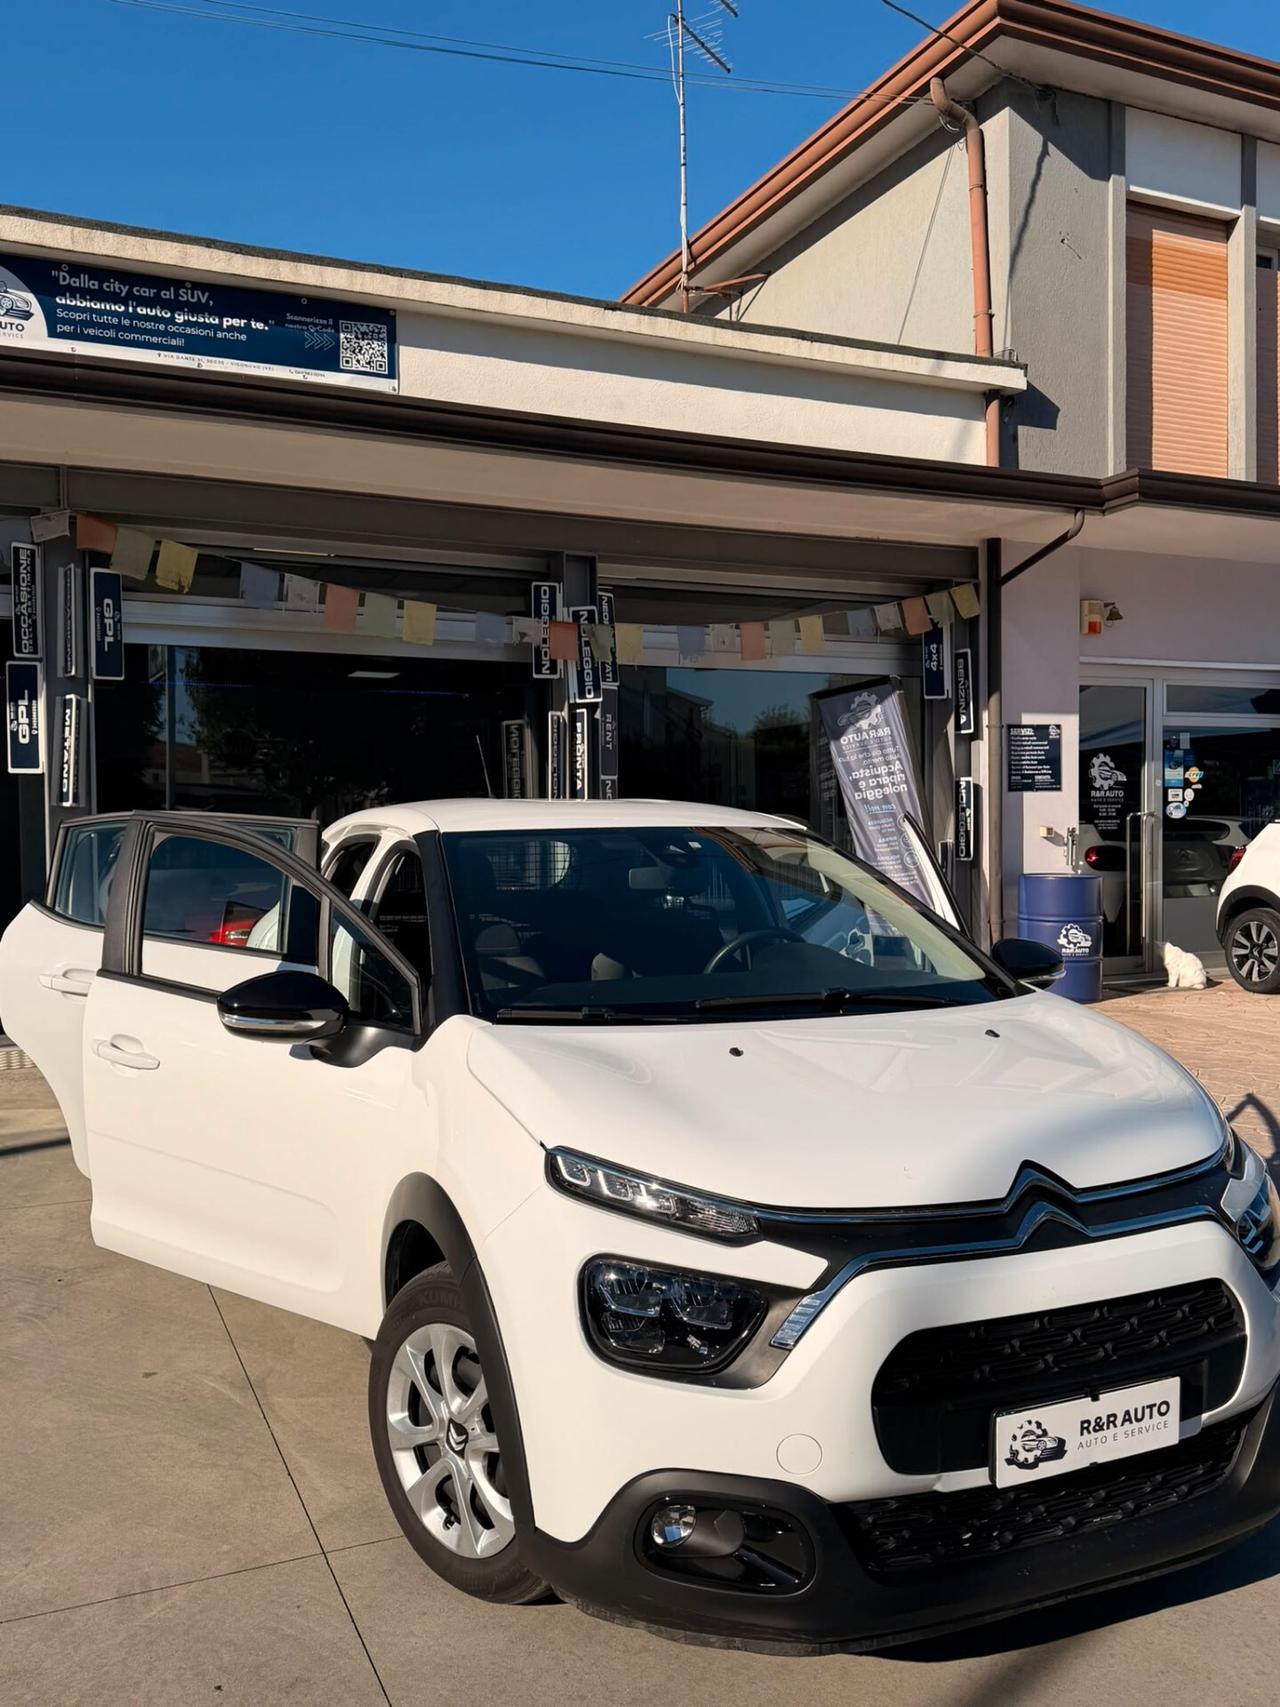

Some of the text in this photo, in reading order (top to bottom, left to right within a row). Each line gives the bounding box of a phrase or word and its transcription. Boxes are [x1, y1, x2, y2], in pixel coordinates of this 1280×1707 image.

[56, 292, 125, 312] abbiamo
[129, 301, 171, 318] l'auto
[175, 308, 219, 324] giusta
[223, 317, 247, 329] per
[103, 279, 129, 296] city
[133, 286, 157, 297] car
[161, 287, 174, 299] al
[179, 288, 213, 306] SUV,
[0, 321, 24, 332] UTO
[56, 309, 247, 341] Scopri tutte le nostre occasioni anche
[57, 324, 185, 347] per i veicoli commerciali!
[20, 548, 29, 653] OCCASIONE
[103, 598, 114, 652] GPL
[541, 586, 550, 674] NOLEGGIO
[930, 643, 938, 671] 4x4
[957, 658, 967, 725] BENZINA
[18, 690, 30, 744] GPL
[959, 781, 967, 857] NOLEGGIO
[1077, 1420, 1169, 1450] AUTO E SERVICE
[1080, 1400, 1170, 1437] R&R AUTO
